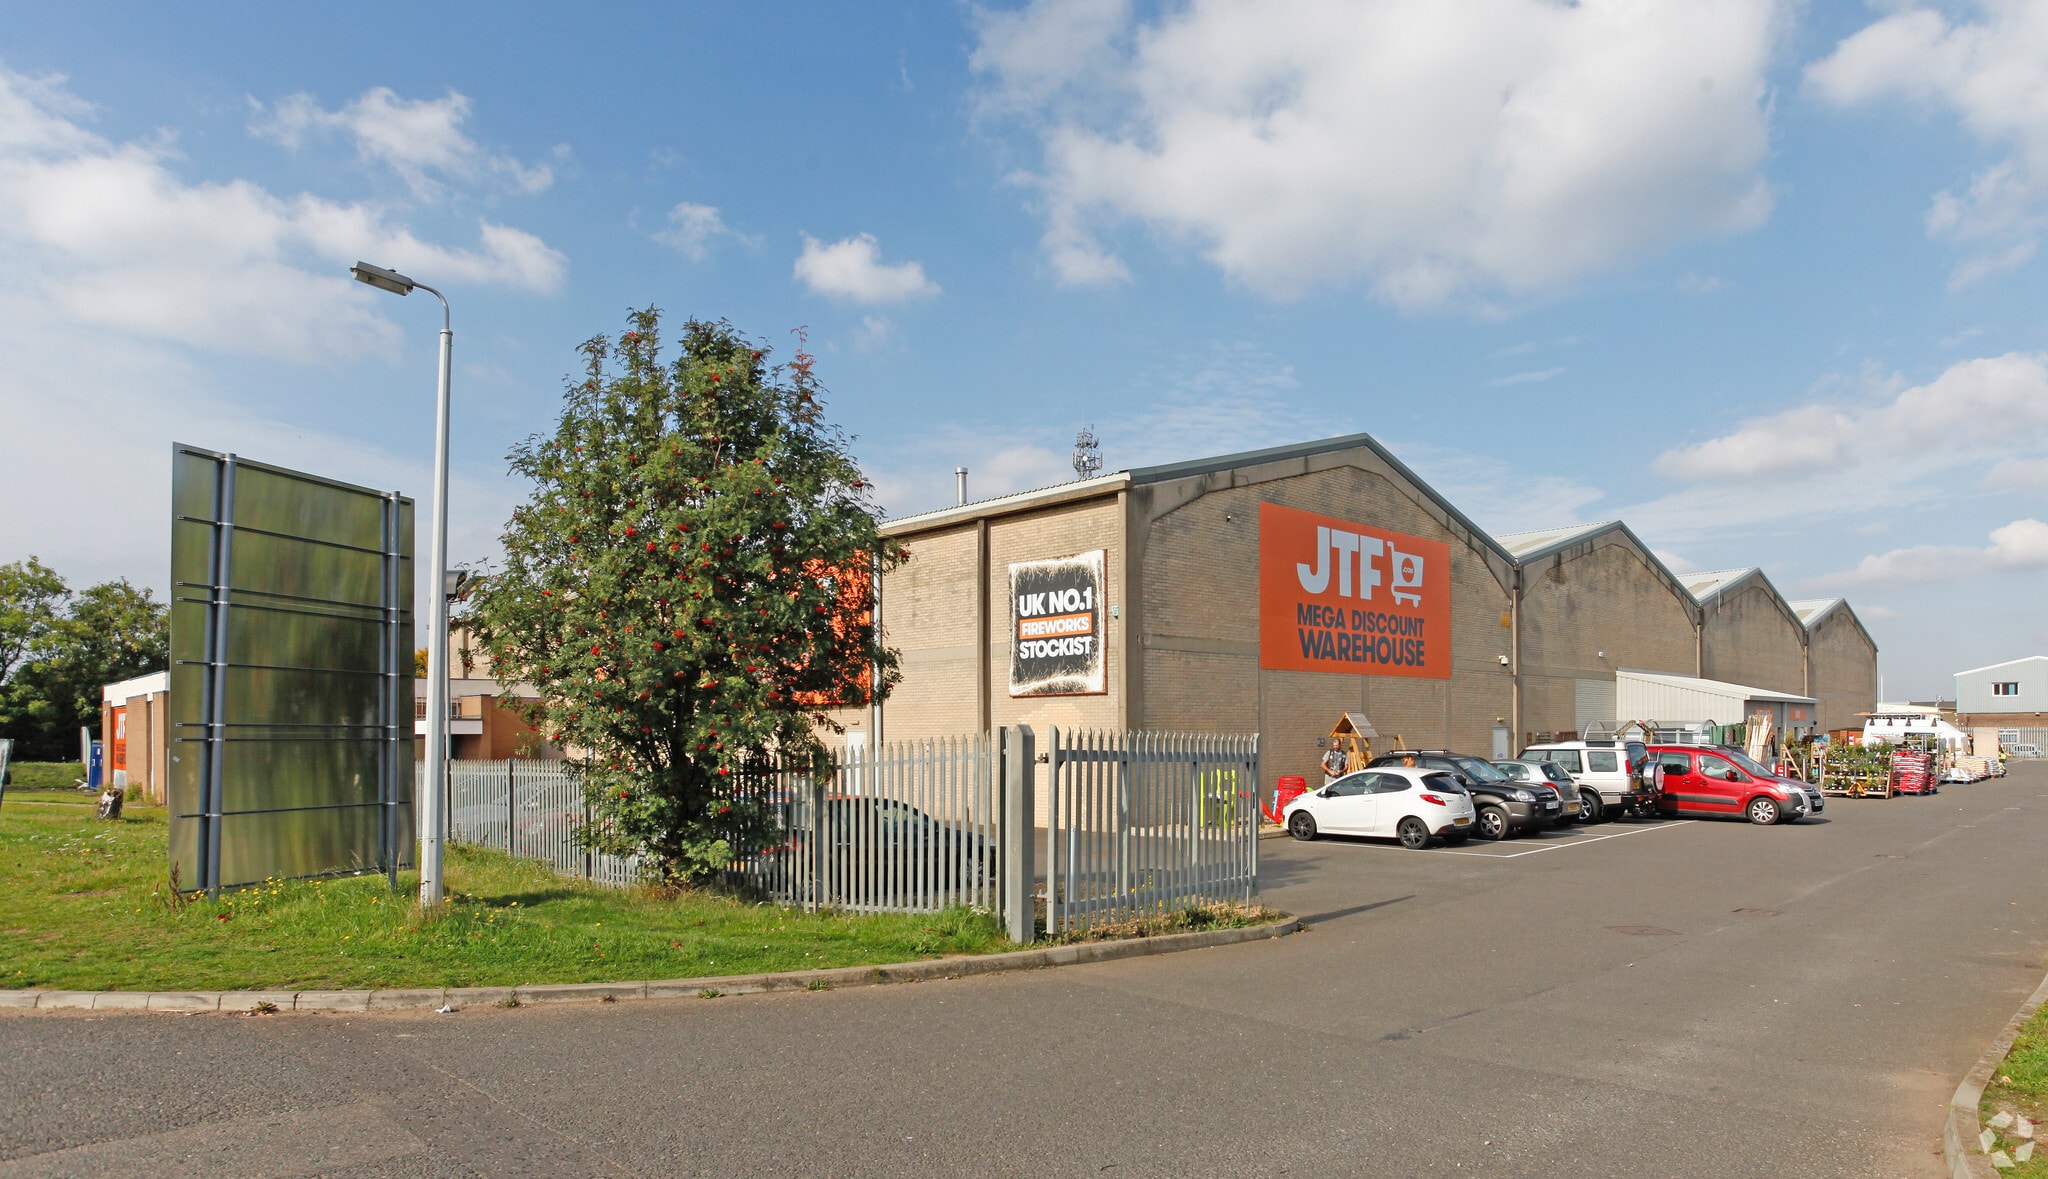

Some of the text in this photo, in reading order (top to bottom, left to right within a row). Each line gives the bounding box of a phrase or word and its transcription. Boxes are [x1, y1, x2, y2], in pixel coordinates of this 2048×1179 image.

[1296, 525, 1384, 600] JTF
[1019, 586, 1093, 617] UK NO.1
[1021, 616, 1090, 637] FIREWORKS
[1297, 602, 1425, 638] MEGA DISCOUNT
[1019, 636, 1093, 660] STOCKIST
[1298, 628, 1425, 667] WAREHOUSE
[116, 713, 126, 740] JTF
